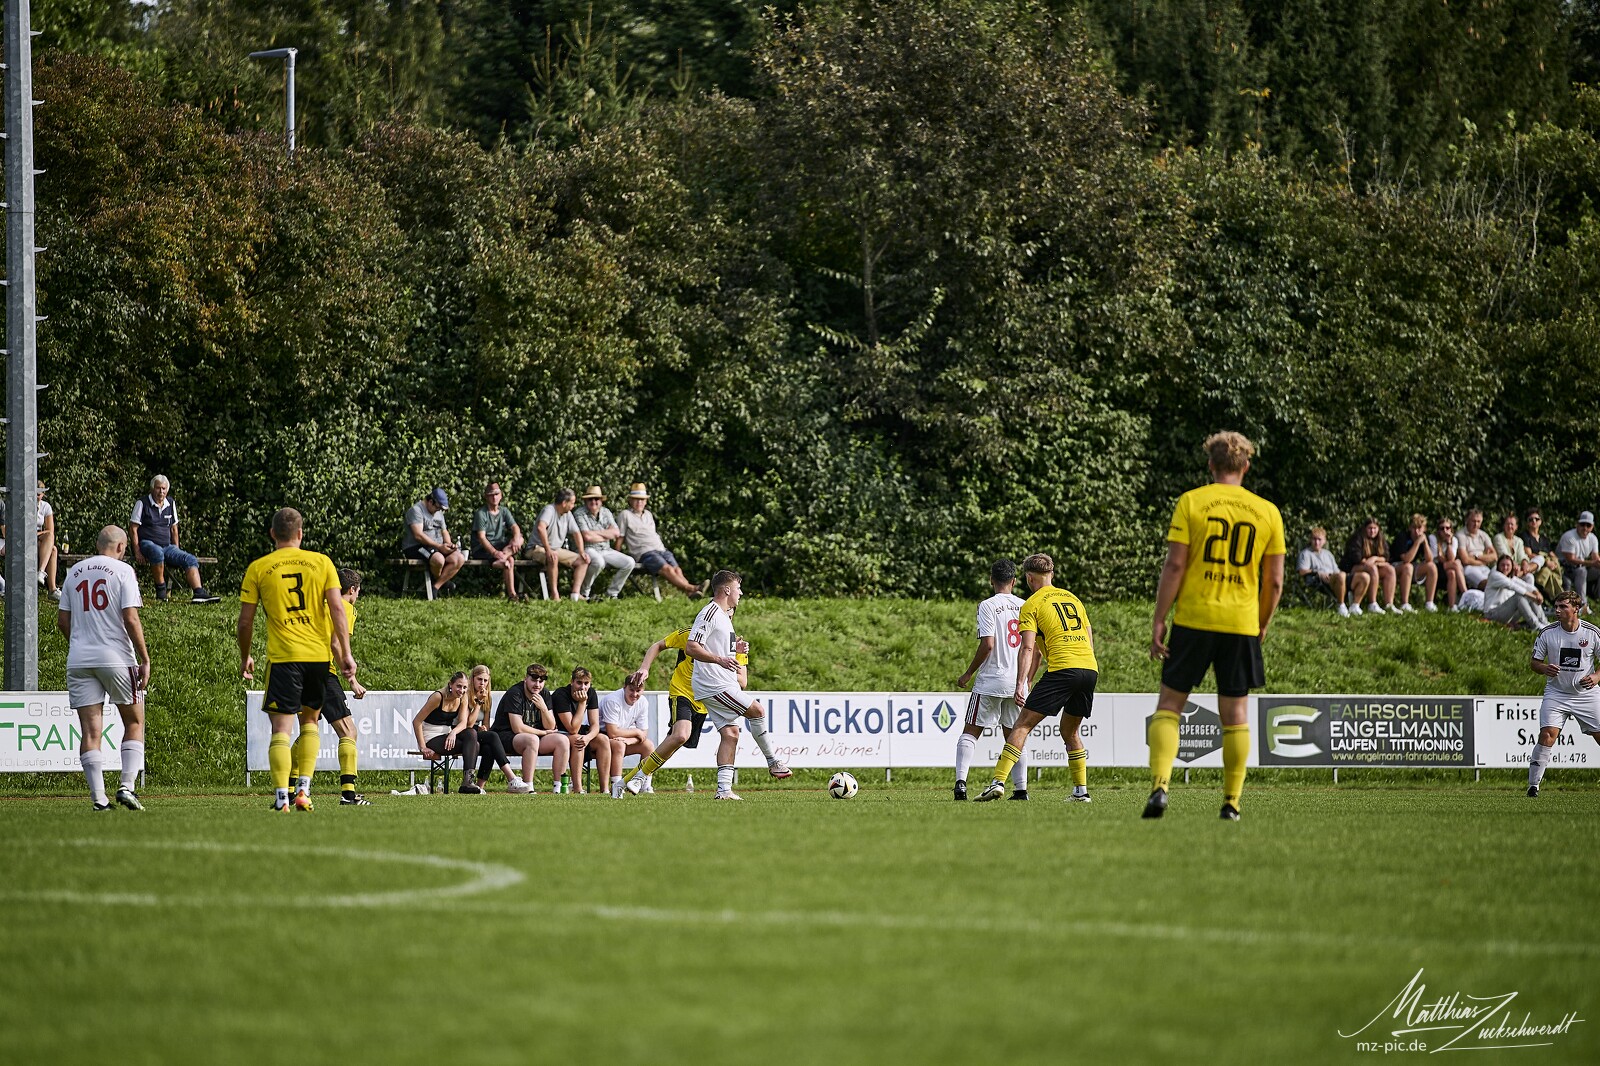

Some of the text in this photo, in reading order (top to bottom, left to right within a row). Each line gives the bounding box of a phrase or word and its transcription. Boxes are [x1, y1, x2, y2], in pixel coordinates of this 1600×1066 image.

[1203, 516, 1257, 567] 20
[73, 564, 115, 578] SV Laufen
[75, 578, 109, 612] 16
[281, 572, 306, 613] 3
[1052, 602, 1082, 632] 19
[788, 700, 923, 734] Nickolai
[1329, 703, 1464, 720] FAHRSCHULE
[0, 722, 117, 751] RANK
[1330, 721, 1464, 738] ENGELMANN
[1517, 728, 1576, 746] SARA
[816, 738, 882, 757] Wärme!
[1330, 739, 1464, 751] LAUFEN TITTMONING
[1031, 749, 1065, 761] Telefon
[1331, 751, 1464, 763] www.engelmann-fahrschule.de
[1505, 752, 1532, 763] Laufe
[1569, 752, 1587, 763] 478
